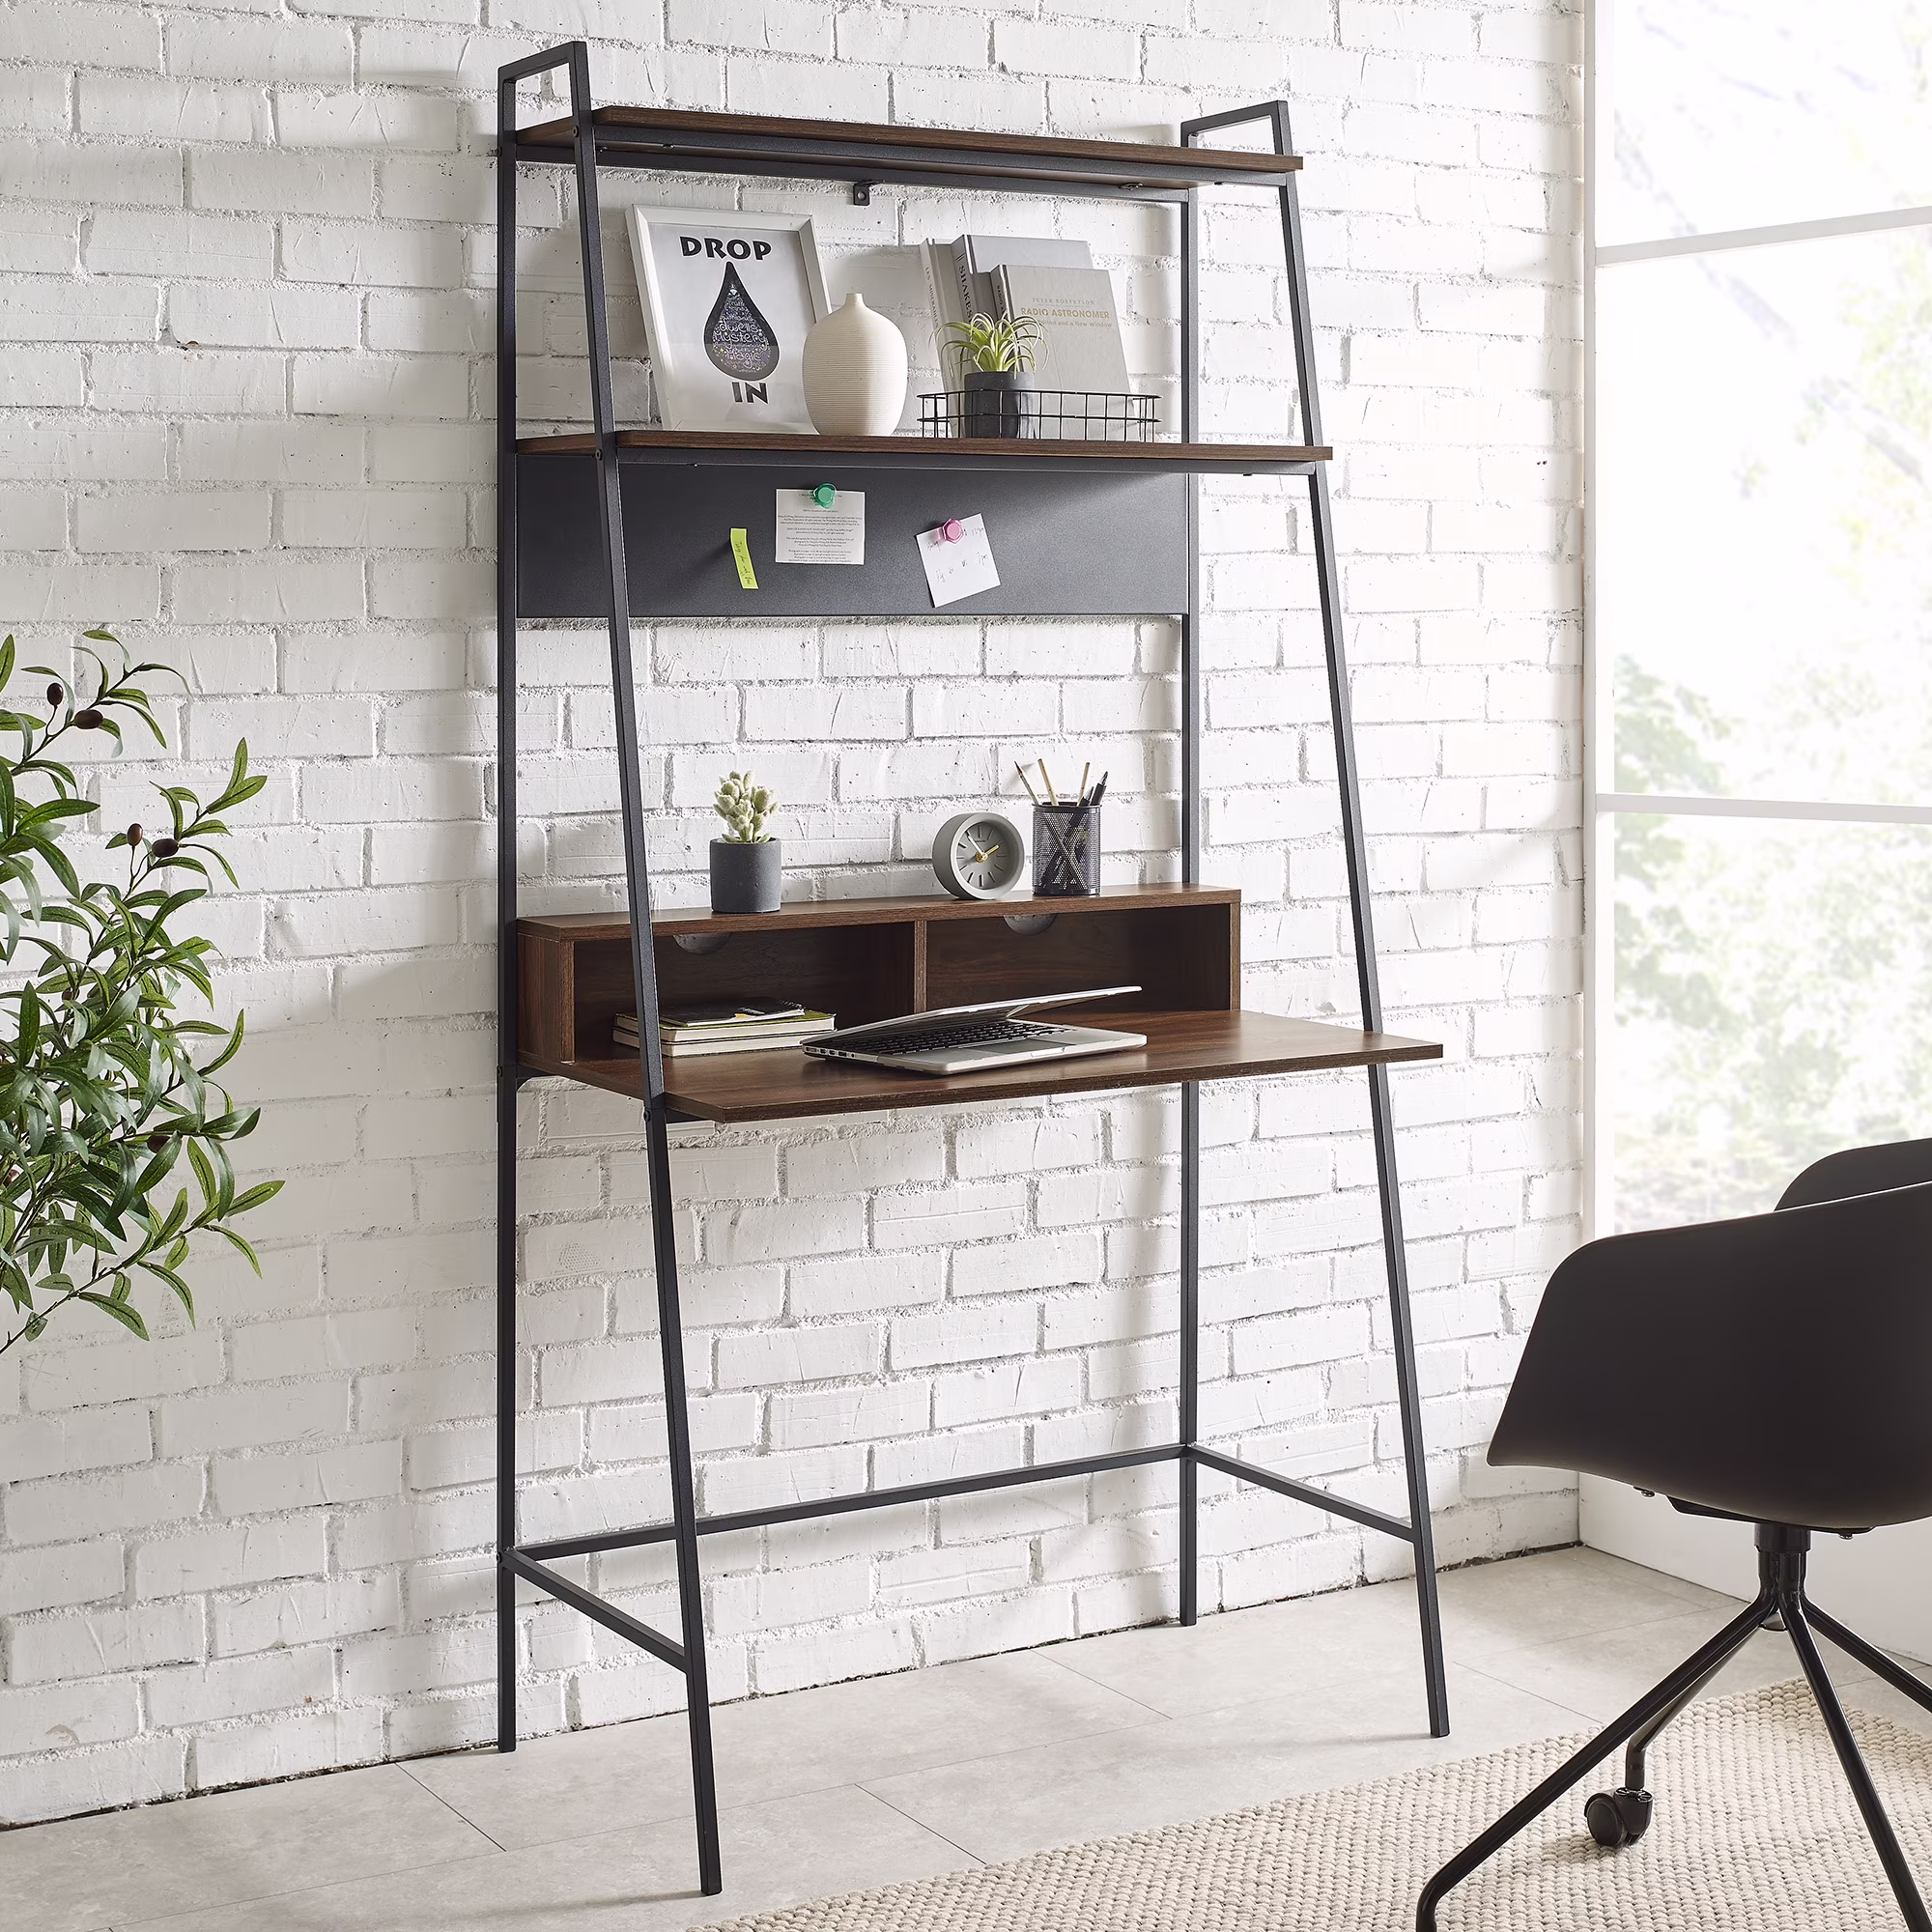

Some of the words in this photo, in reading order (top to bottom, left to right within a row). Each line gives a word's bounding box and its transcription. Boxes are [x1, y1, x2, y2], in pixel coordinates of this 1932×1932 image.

[679, 236, 772, 260] DROP
[1020, 307, 1049, 316] RADIO
[1051, 309, 1110, 319] ASTRONOMER
[731, 382, 769, 404] IN
